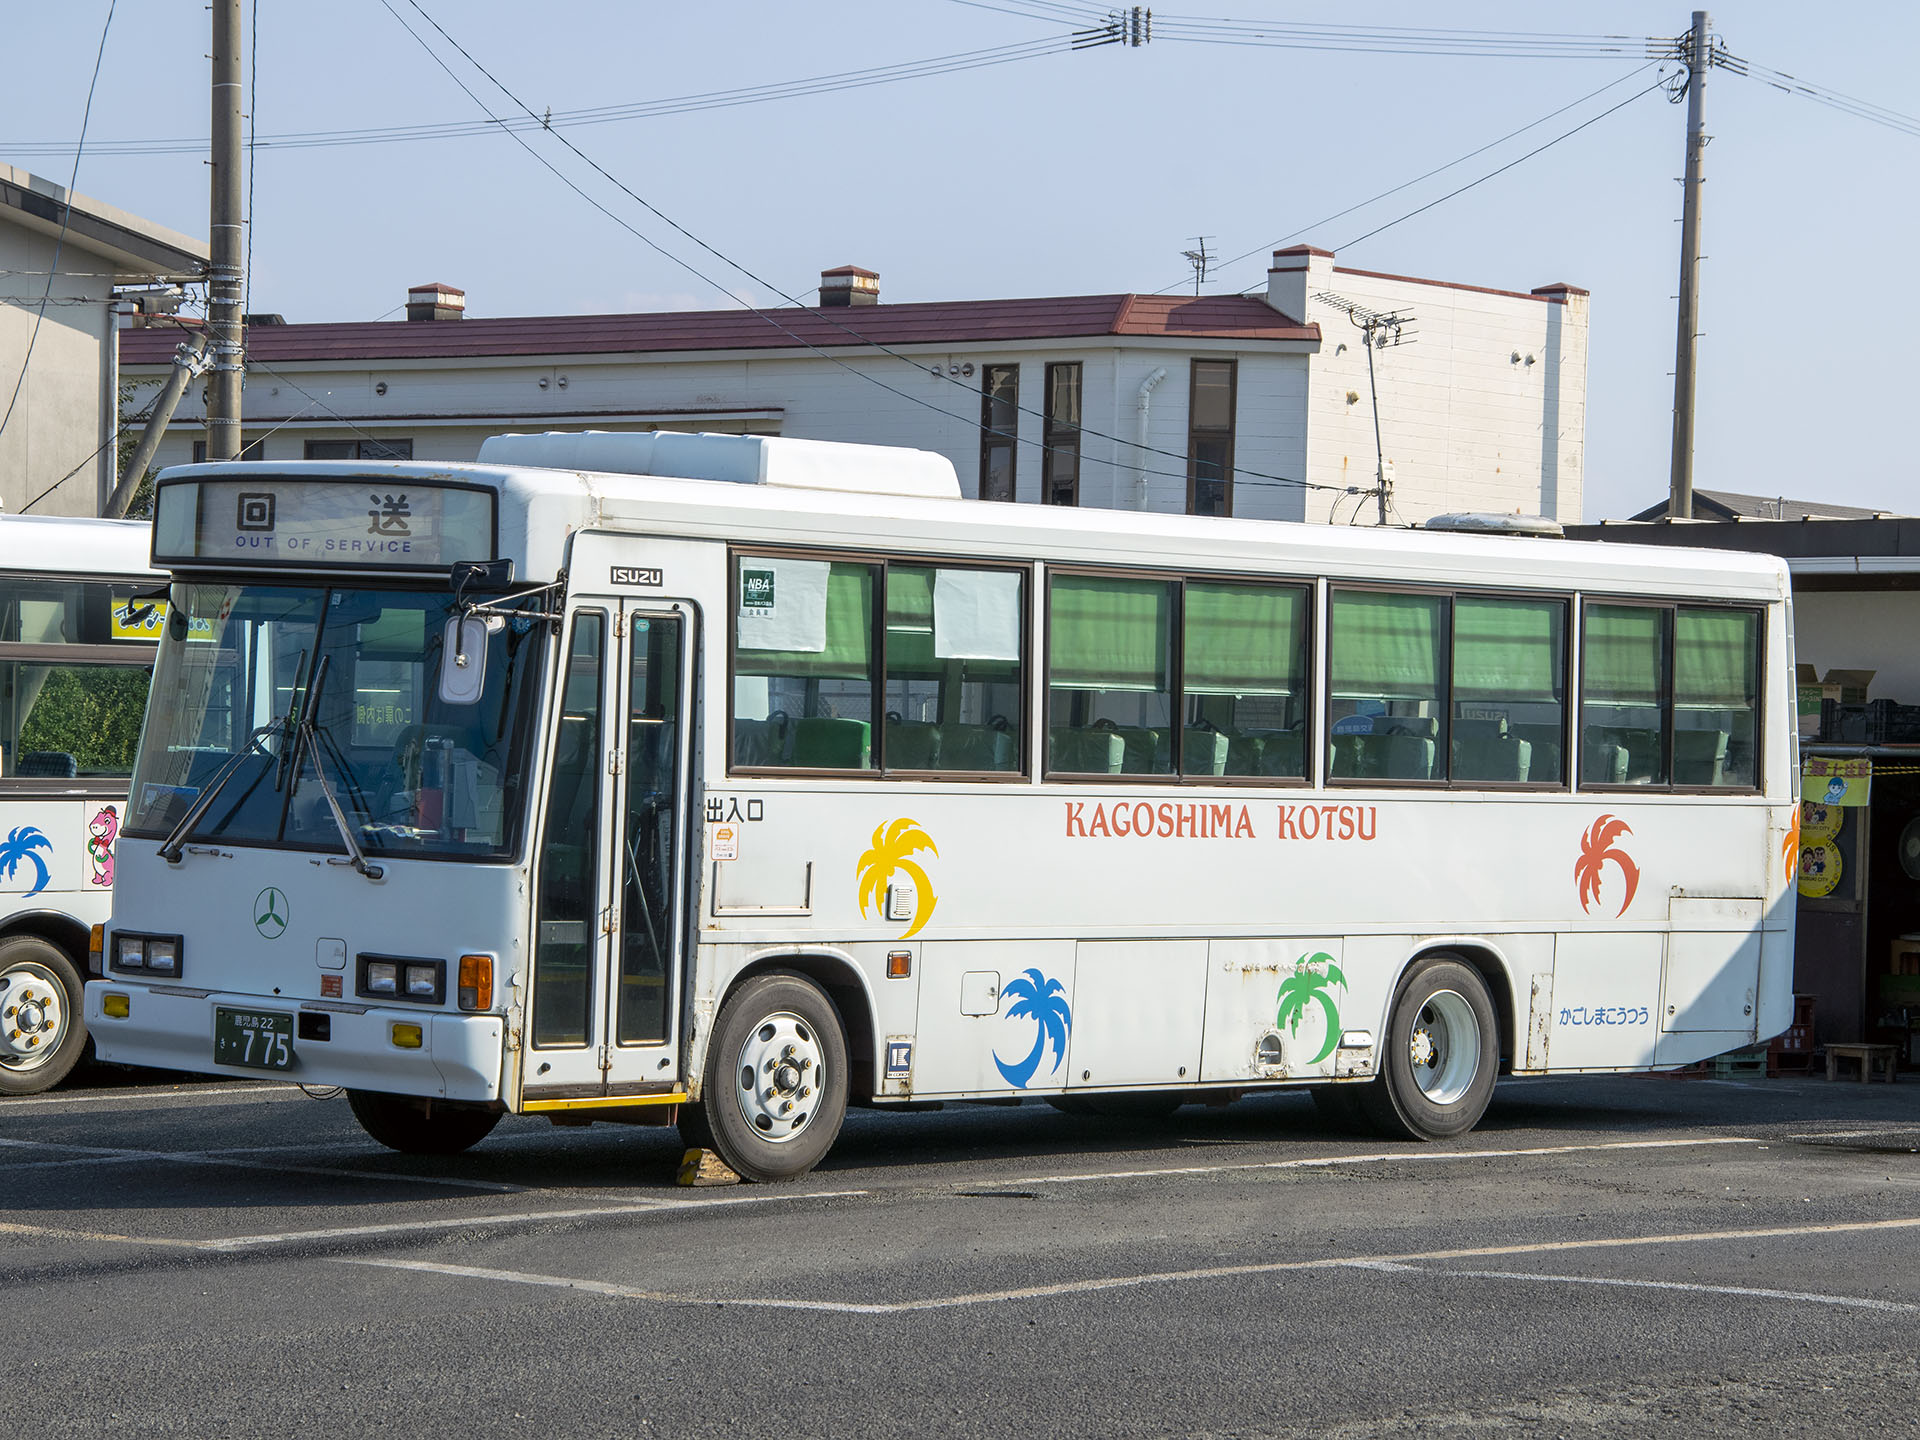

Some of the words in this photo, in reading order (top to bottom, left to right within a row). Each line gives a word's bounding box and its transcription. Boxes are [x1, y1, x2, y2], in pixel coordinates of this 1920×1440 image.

[236, 492, 412, 537] 回送
[235, 535, 274, 549] OUT
[287, 537, 312, 550] OF
[324, 538, 412, 553] SERVICE
[612, 568, 661, 584] ISUZU
[747, 577, 770, 590] NBA
[706, 796, 764, 824] 出入口
[1064, 801, 1257, 840] KAGOSHIMA
[1277, 804, 1377, 841] KOTSU
[260, 1017, 274, 1030] 22
[1559, 1006, 1649, 1026] かごしまこうつう
